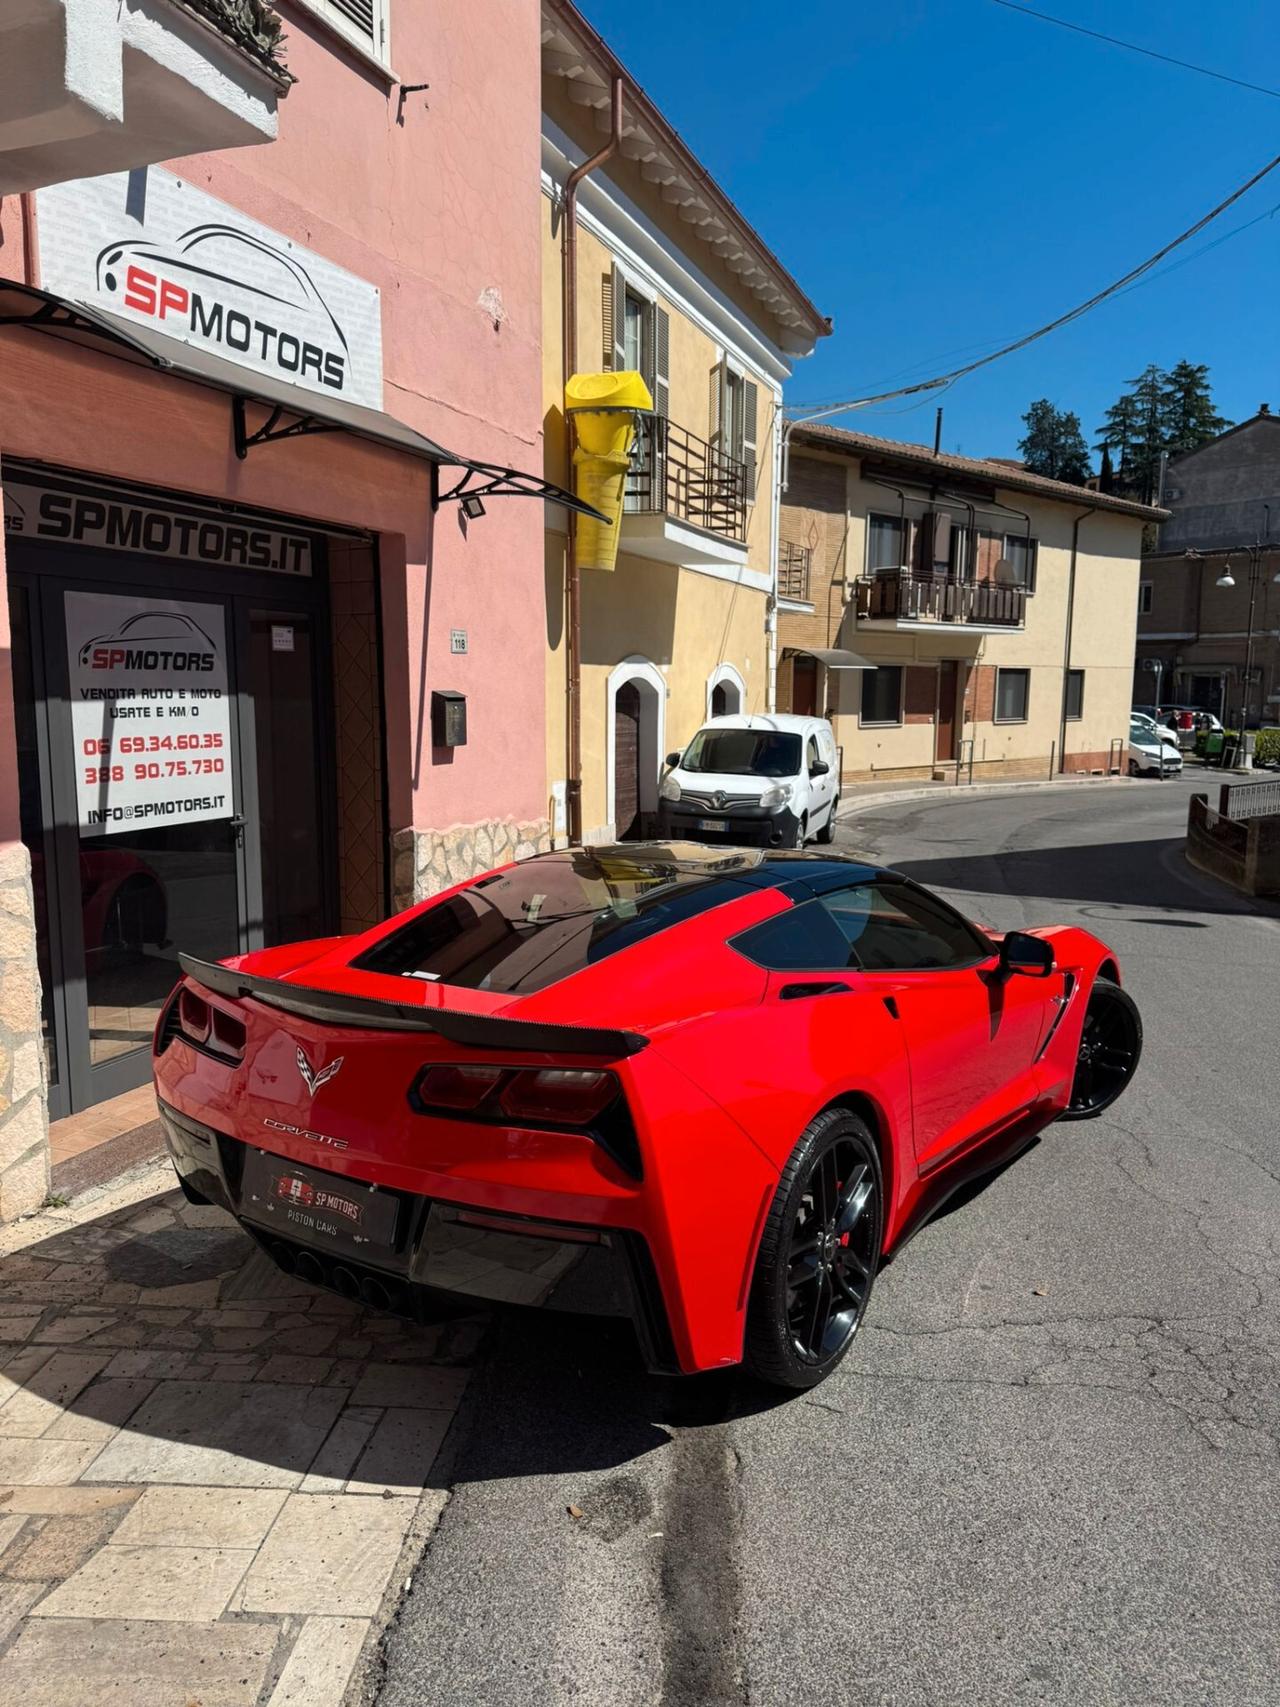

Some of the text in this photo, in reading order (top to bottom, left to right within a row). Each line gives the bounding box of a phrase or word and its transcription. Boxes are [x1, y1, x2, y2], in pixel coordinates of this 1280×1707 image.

[124, 264, 345, 391] SPMOTORS
[37, 492, 309, 573] SPMOTORS.IT
[454, 639, 465, 650] 118
[91, 648, 215, 672] SPMOTORS
[80, 688, 222, 700] VENDITA AUTO E MOTO
[110, 706, 151, 719] USATE
[156, 706, 163, 717] E
[83, 733, 223, 756] 06 69.34.60.35
[135, 758, 224, 780] 90.75.730
[87, 795, 225, 824] INFO@SPMOTORS.IT
[263, 1118, 349, 1150] CORVETTE
[315, 1192, 359, 1219] SP MOTORS
[287, 1209, 338, 1236] PISTON CARS
